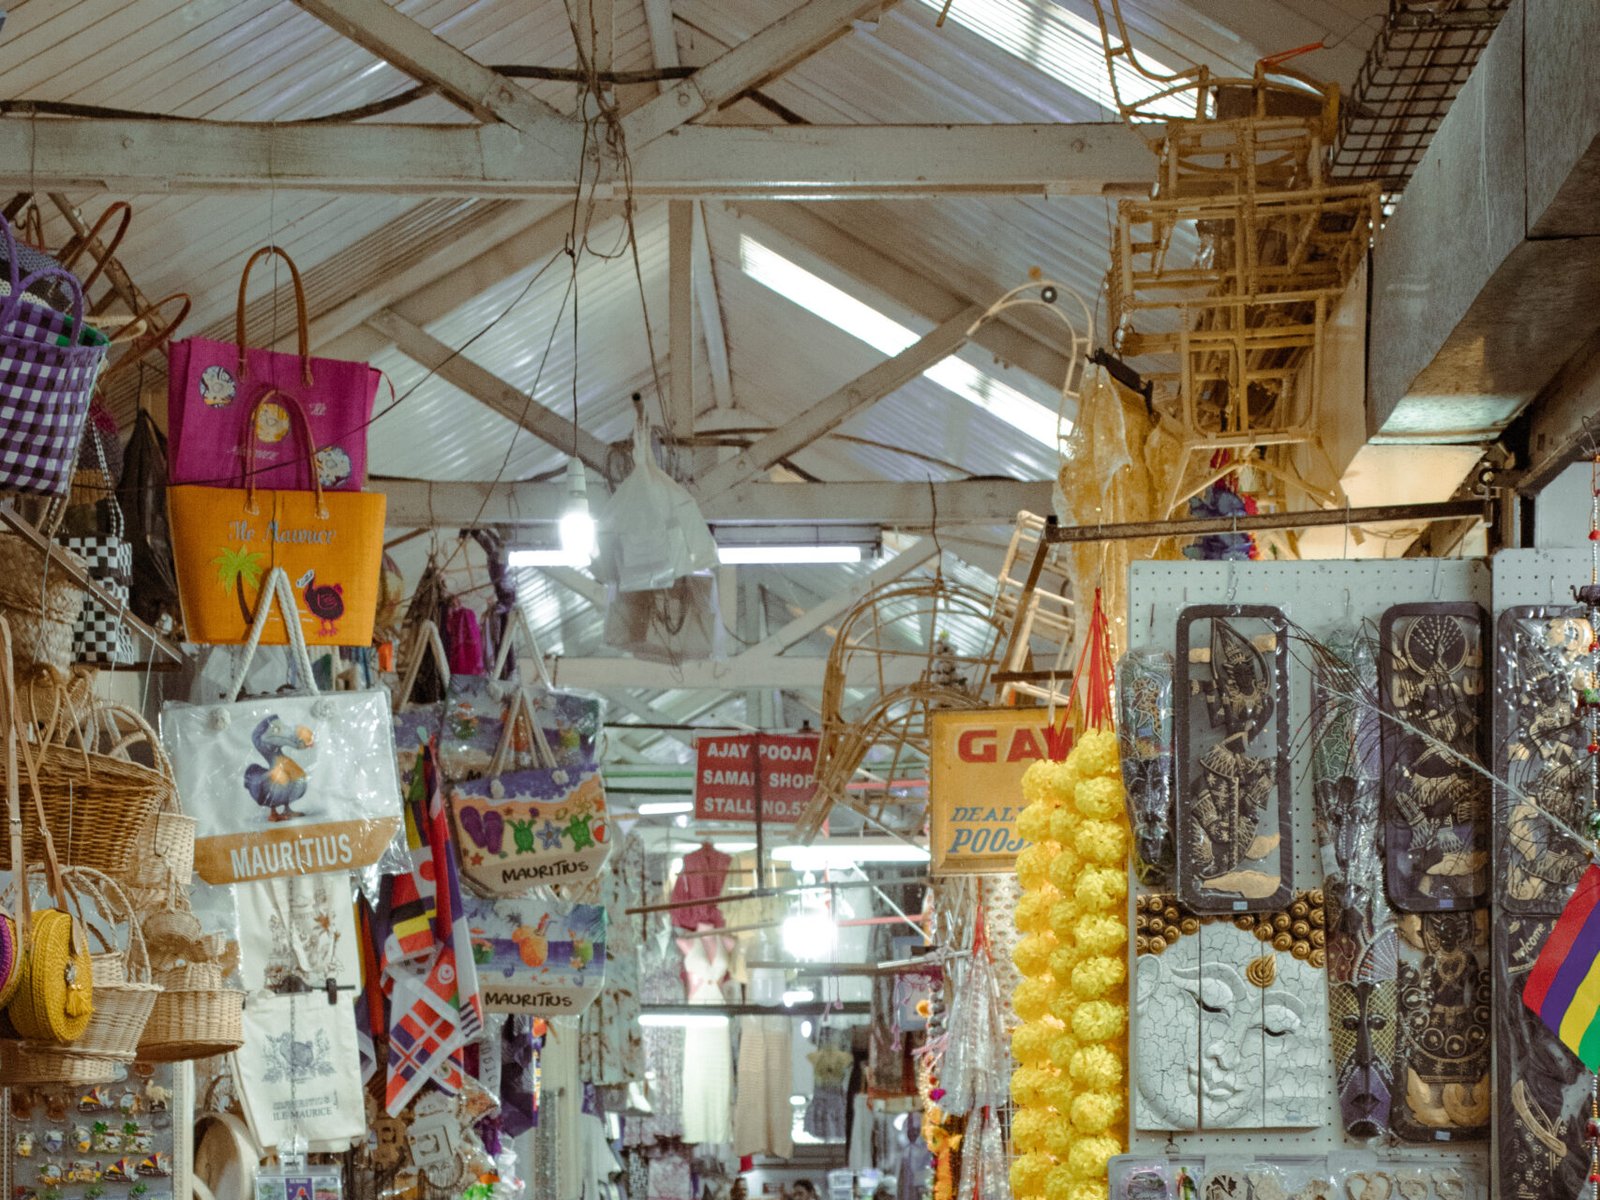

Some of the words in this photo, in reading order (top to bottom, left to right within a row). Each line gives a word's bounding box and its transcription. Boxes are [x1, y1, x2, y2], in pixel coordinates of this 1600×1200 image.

[707, 743, 750, 758] AJAY
[758, 744, 813, 761] POOJA
[769, 773, 814, 789] SHOP
[704, 797, 754, 814] STALL
[948, 828, 1033, 853] POOJ
[230, 833, 353, 879] MAURITIUS
[502, 860, 589, 883] MAURITIUS
[485, 992, 573, 1008] MAURITIUS
